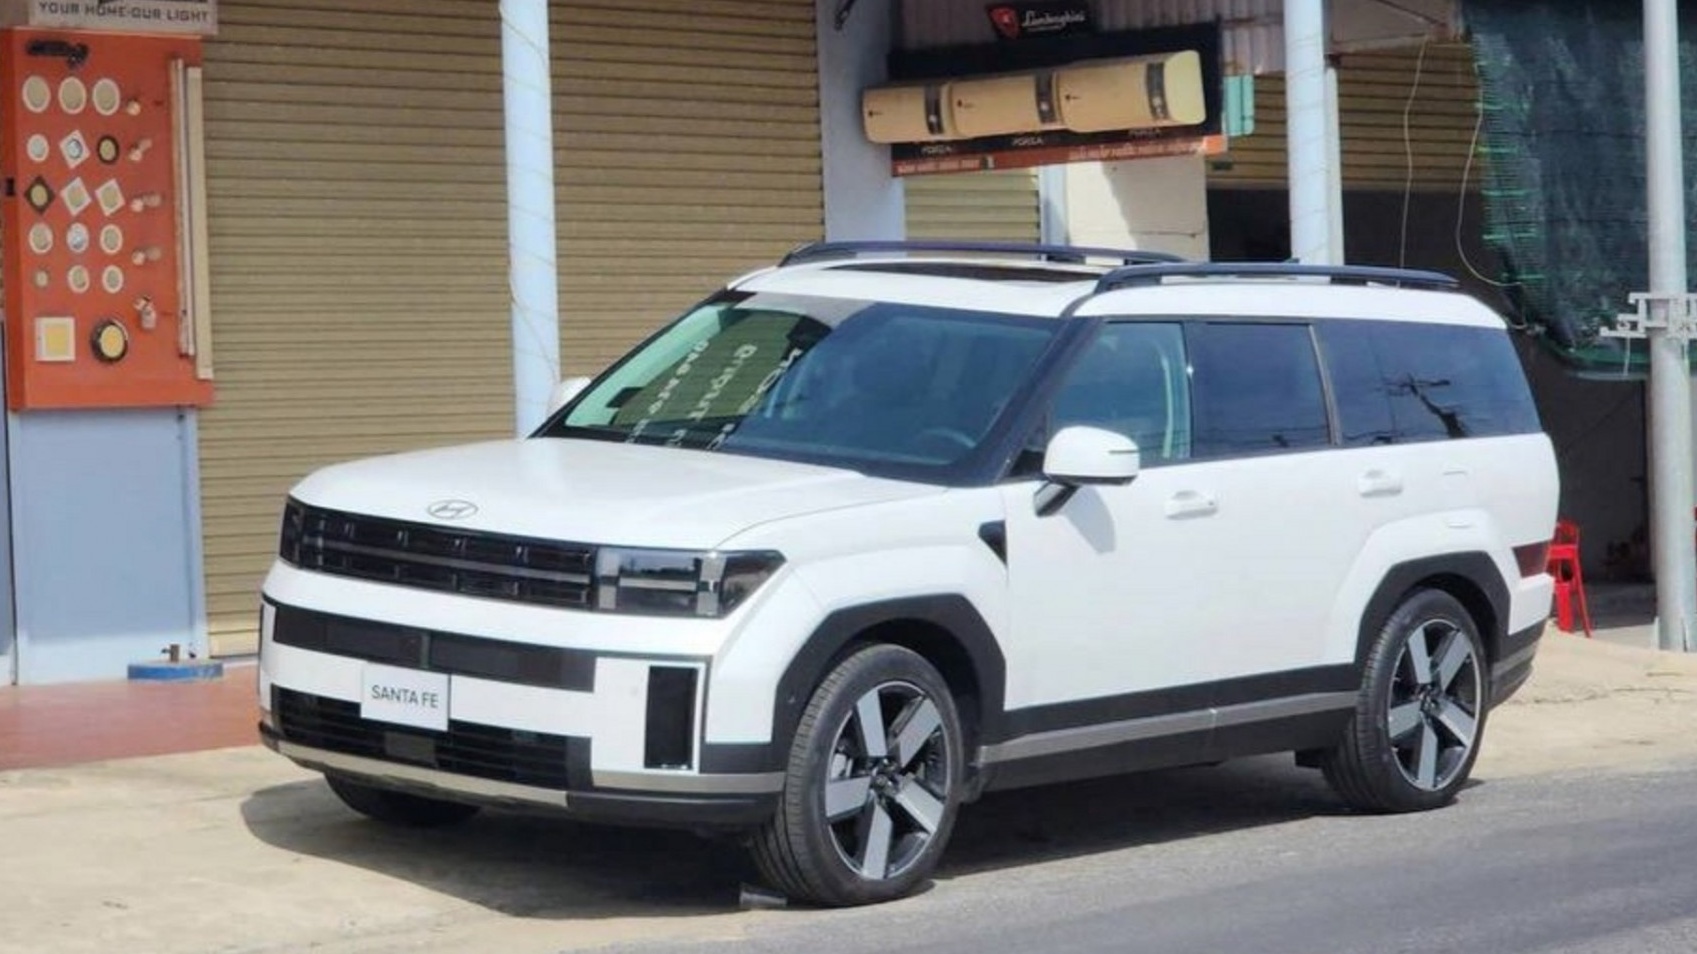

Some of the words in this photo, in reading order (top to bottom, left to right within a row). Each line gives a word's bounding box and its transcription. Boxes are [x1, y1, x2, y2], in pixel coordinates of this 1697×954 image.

[39, 2, 80, 15] YOUR
[166, 9, 209, 22] LIGHT
[371, 684, 419, 706] SANTA
[421, 692, 439, 709] FE
